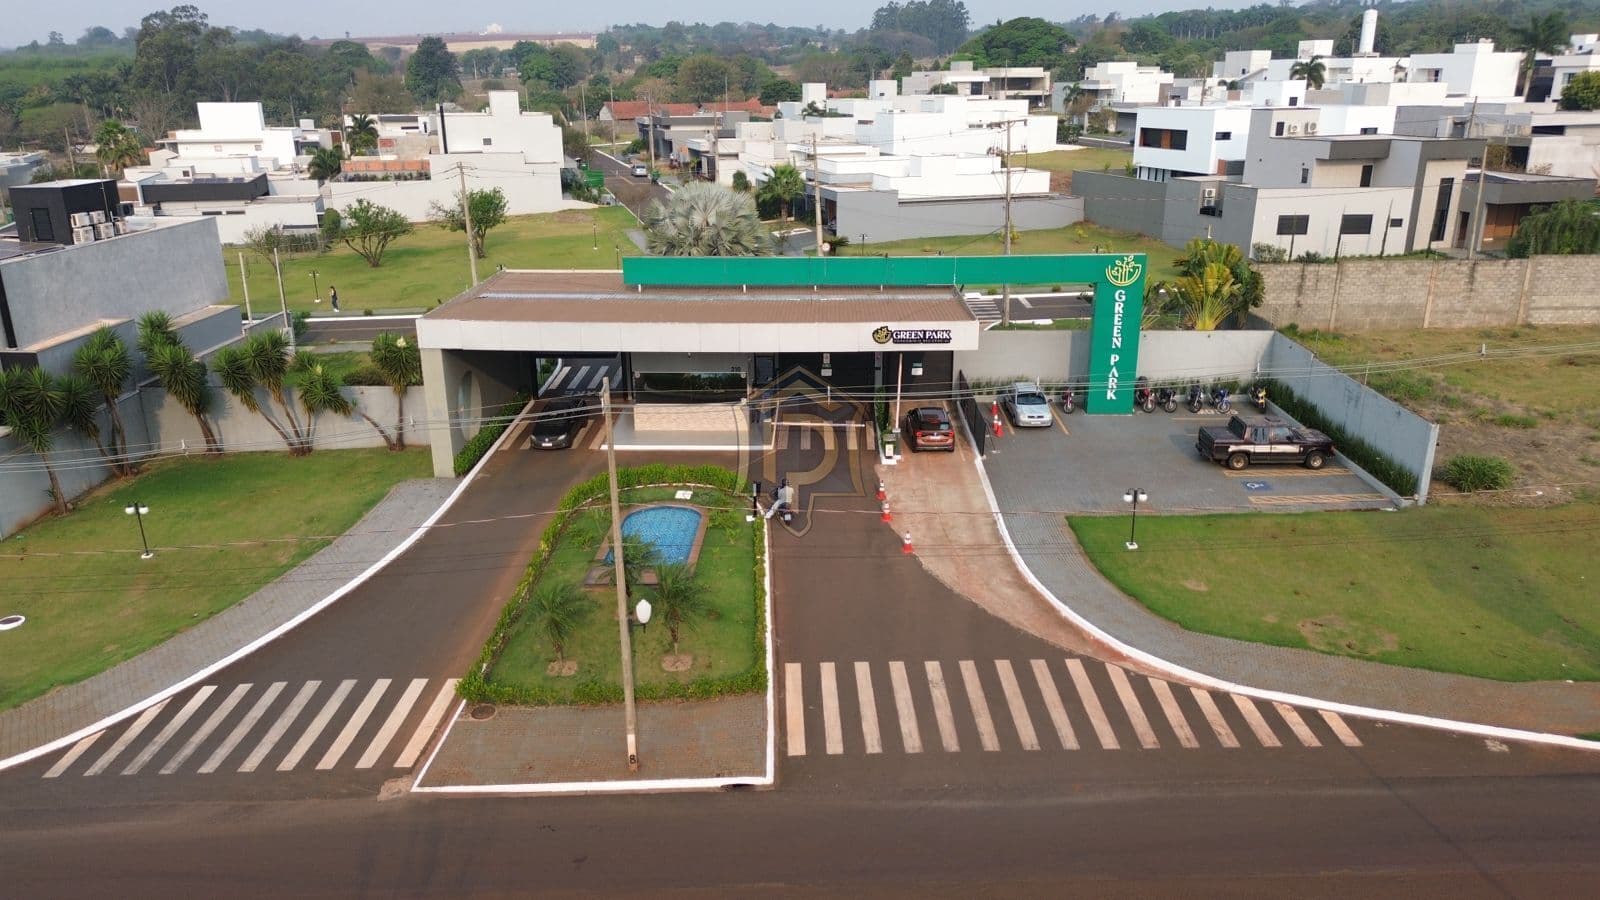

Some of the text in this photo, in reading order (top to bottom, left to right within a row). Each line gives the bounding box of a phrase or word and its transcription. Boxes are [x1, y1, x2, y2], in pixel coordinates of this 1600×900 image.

[893, 330, 952, 339] GREEN PARK
[1106, 289, 1127, 400] GREEN PARK
